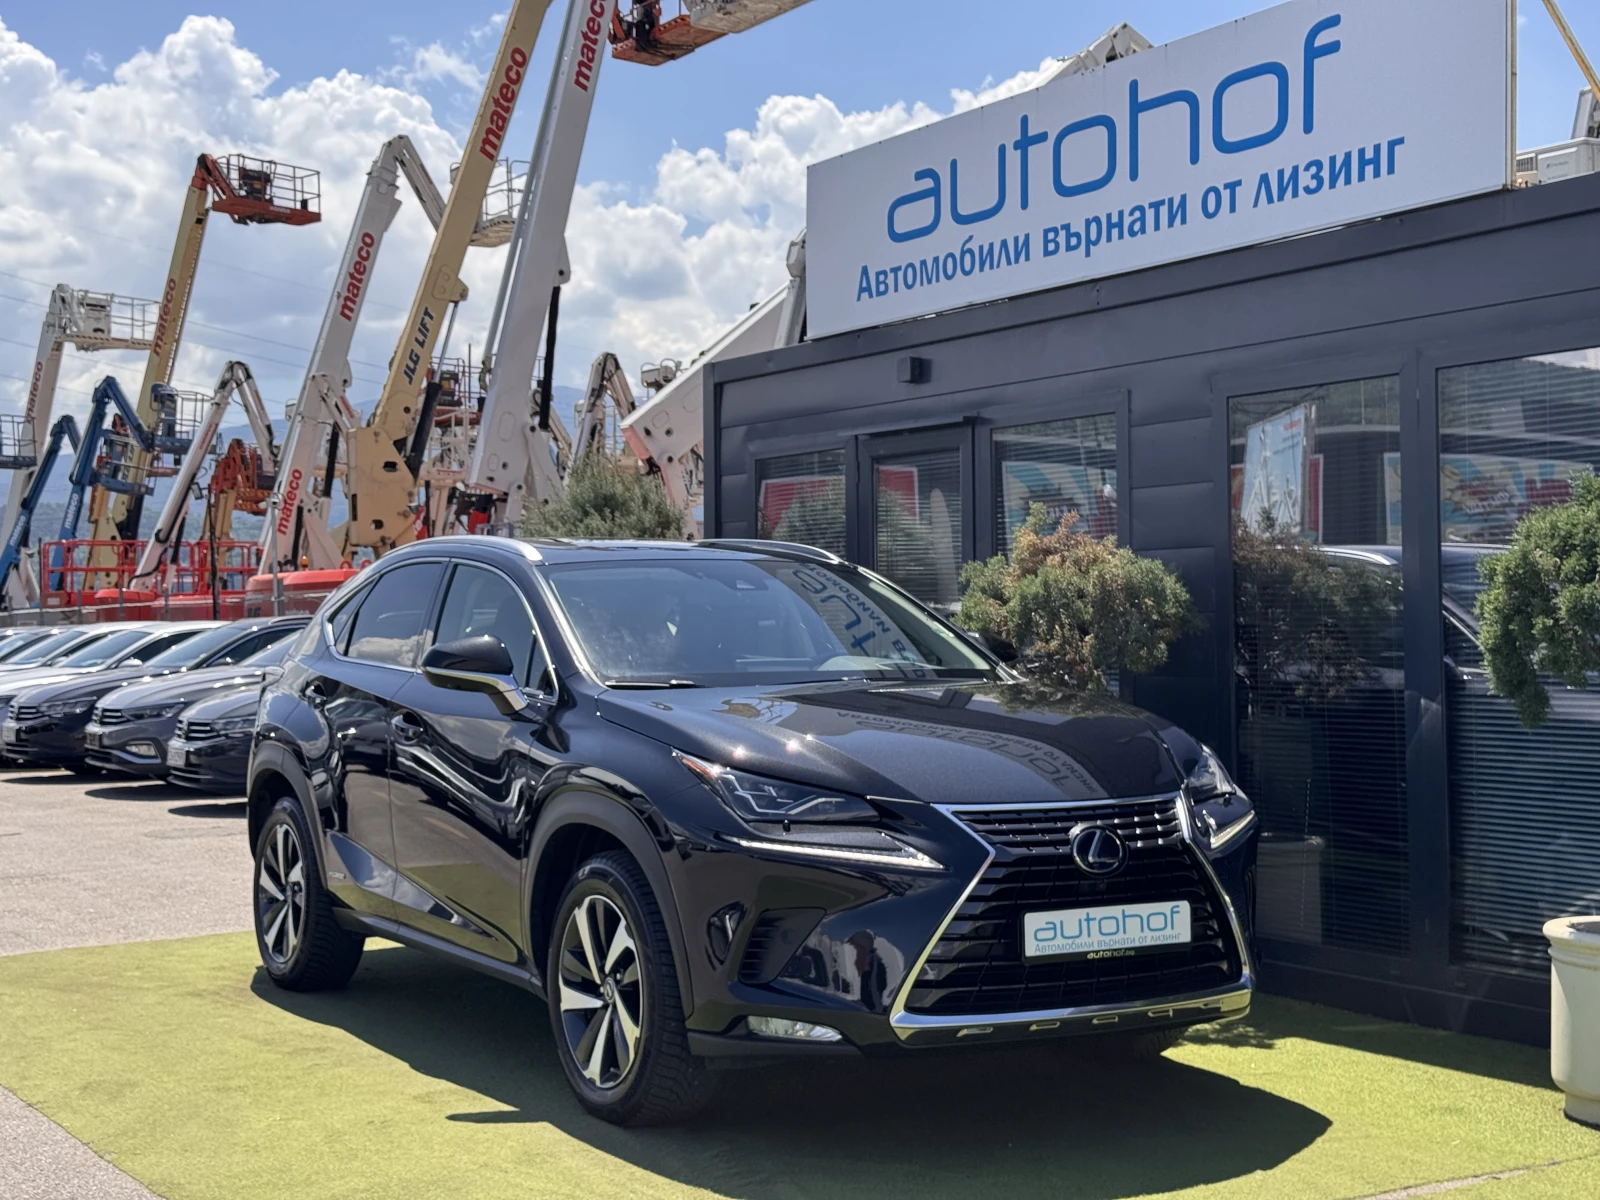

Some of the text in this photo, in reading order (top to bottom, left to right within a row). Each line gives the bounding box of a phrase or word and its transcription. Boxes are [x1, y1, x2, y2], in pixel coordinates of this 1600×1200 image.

[573, 0, 606, 92] matec
[479, 46, 528, 162] mateco
[887, 13, 1342, 243] autohof
[856, 136, 1405, 302] Автомобили върнати от лизинг
[153, 278, 177, 356] mateco
[339, 231, 376, 322] mateco
[403, 305, 435, 386] JLG LIFT
[64, 493, 80, 530] mateco
[277, 468, 303, 536] mateco
[1033, 904, 1181, 942] autohof
[1034, 933, 1181, 954] Автомобили върнати от лизинг
